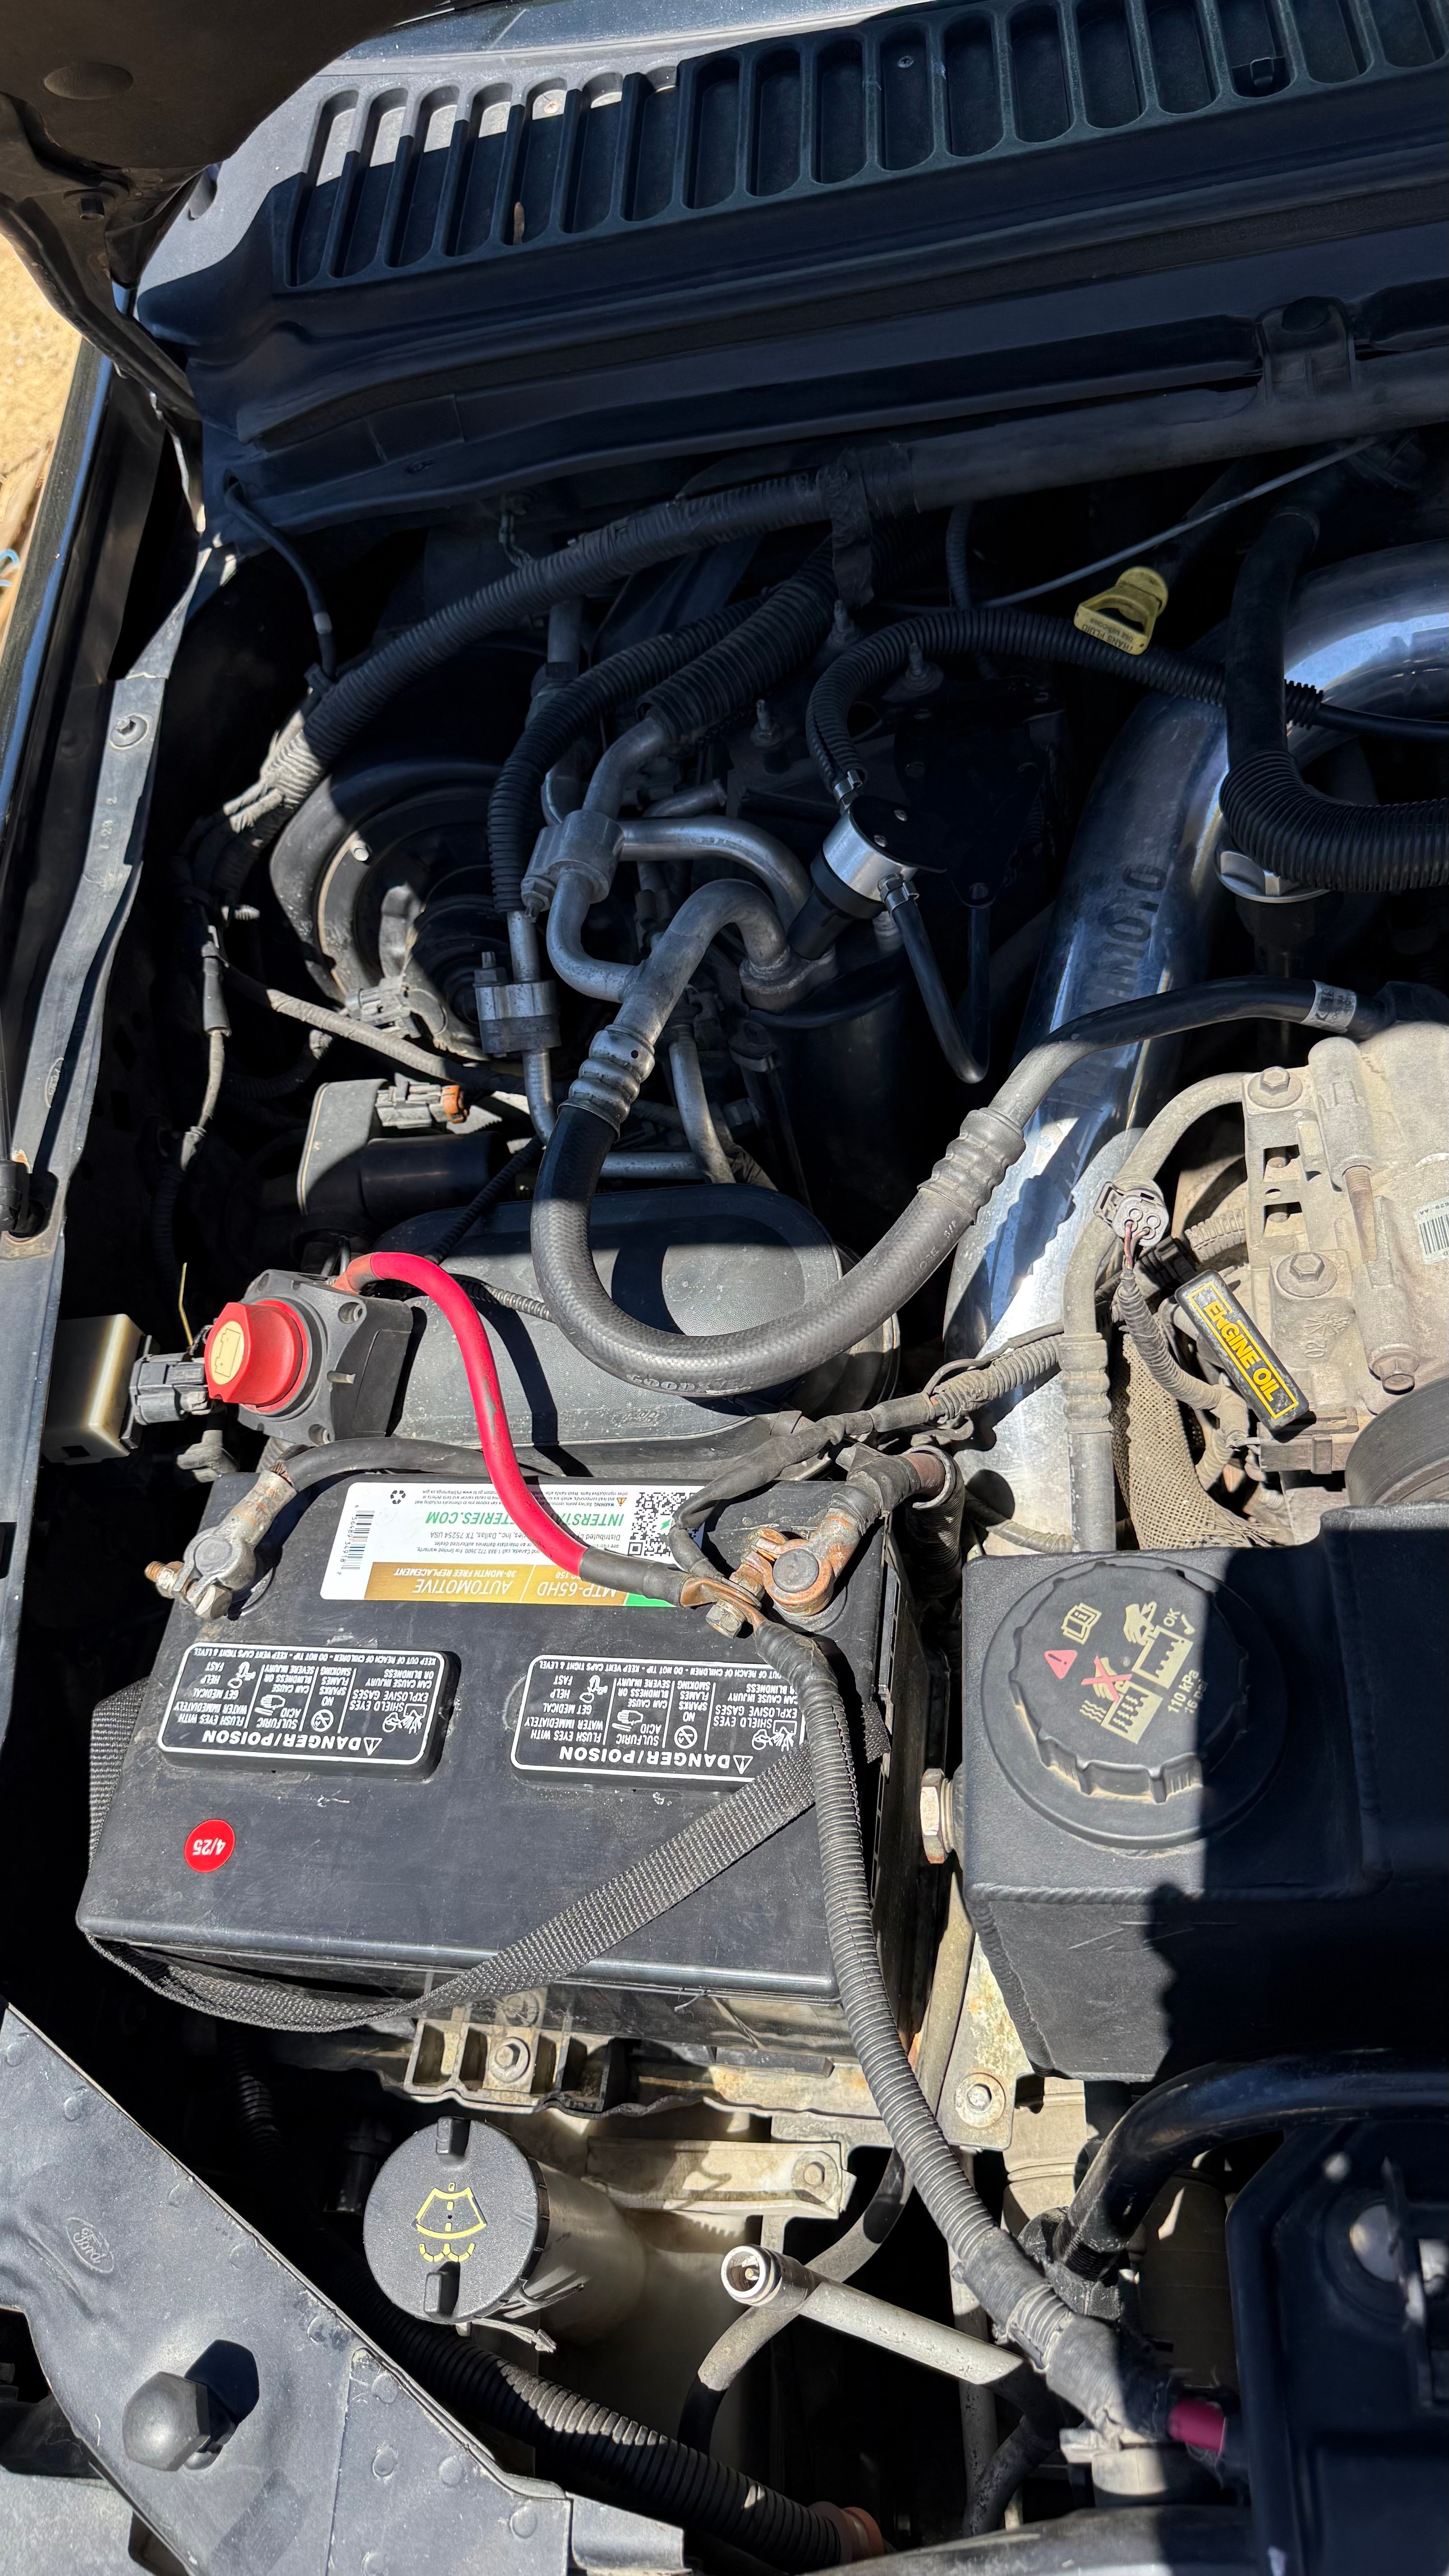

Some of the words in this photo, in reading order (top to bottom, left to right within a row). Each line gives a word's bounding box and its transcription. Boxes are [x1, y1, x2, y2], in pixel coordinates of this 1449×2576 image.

[1082, 624, 1105, 638] FLUID
[1107, 635, 1133, 652] TRANS
[1204, 1300, 1261, 1369] ENGINE
[1253, 1368, 1279, 1403] OIL
[393, 1568, 452, 1576] REPLACEMENT
[452, 1569, 472, 1577] FREE
[474, 1569, 517, 1578] 30-MONTH
[412, 1578, 513, 1595] AUTOMOTIVE
[537, 1581, 616, 1598] MTP-65HD
[1163, 1608, 1181, 1627] OK
[194, 1647, 212, 1656] LEVEL
[219, 1649, 237, 1657] TIGHT
[237, 1650, 254, 1658] CAPS
[255, 1651, 271, 1659] VENT
[271, 1651, 288, 1660] KEEP
[305, 1653, 318, 1661] NOT
[334, 1654, 365, 1662] CHILDREN
[365, 1655, 374, 1663] OF
[376, 1655, 396, 1664] REACH
[420, 1657, 436, 1665] KEEP
[205, 1662, 225, 1671] FAST
[263, 1665, 289, 1673] INJURY
[290, 1665, 315, 1673] SEVERE
[539, 1661, 559, 1669] LEVEL
[560, 1661, 565, 1670] &
[566, 1662, 585, 1670] TIGHT
[586, 1662, 604, 1671] CAPS
[605, 1664, 621, 1672] VENT
[659, 1666, 672, 1674] NOT
[320, 1666, 352, 1675] SMOKING
[383, 1669, 422, 1679] BLINDNESS
[424, 1670, 434, 1679] OR
[690, 1667, 723, 1677] CHILDREN
[724, 1669, 733, 1677] OF
[734, 1669, 756, 1678] REACH
[768, 1671, 782, 1679] OUT
[200, 1674, 221, 1684] HELP
[263, 1674, 274, 1682] OR
[276, 1674, 313, 1684] BLINDNESS
[321, 1676, 349, 1686] FLAMES
[365, 1678, 392, 1687] INJURY
[553, 1675, 573, 1685] FAST
[616, 1678, 642, 1687] INJURY
[271, 1684, 294, 1693] CAUSE
[393, 1679, 416, 1688] CAUSE
[417, 1679, 432, 1688] CAN
[644, 1679, 671, 1688] SEVERE
[677, 1680, 710, 1690] SMOKING
[193, 1688, 223, 1699] MEDICAL
[295, 1685, 309, 1693] CAN
[319, 1685, 347, 1695] SPARKS
[550, 1688, 570, 1699] HELP
[618, 1688, 628, 1696] OR
[630, 1688, 669, 1698] BLINDNESS
[746, 1684, 787, 1694] BLINDNESS
[1168, 1692, 1187, 1713] 110
[1178, 1670, 1200, 1692] kPa
[223, 1690, 239, 1699] GET
[352, 1689, 380, 1700] GASES
[383, 1690, 429, 1702] EXPLOSIVE
[680, 1690, 709, 1701] FLAMES
[727, 1693, 755, 1702] INJURY
[757, 1694, 782, 1703] CAUSE
[322, 1696, 334, 1706] NO
[350, 1700, 371, 1711] EYES
[627, 1698, 650, 1707] CAUSE
[652, 1700, 667, 1709] CAN
[678, 1701, 708, 1711] SPARKS
[173, 1701, 221, 1714] IMMEDIATELY
[222, 1704, 247, 1714] WATER
[373, 1701, 405, 1712] SHIELD
[543, 1703, 575, 1714] MEDICAL
[576, 1704, 592, 1715] GET
[715, 1704, 745, 1716] GASES
[280, 1708, 301, 1718] ACID
[683, 1711, 695, 1722] NO
[749, 1706, 797, 1718] EXPLOSIVE
[178, 1713, 197, 1724] WITH
[199, 1714, 219, 1725] EYES
[220, 1716, 245, 1726] FLUSH
[256, 1718, 298, 1729] SULFURIC
[524, 1716, 575, 1729] IMMEDIATELY
[713, 1716, 736, 1727] EYES
[740, 1717, 772, 1729] SHIELD
[577, 1719, 603, 1730] WATER
[640, 1724, 662, 1734] ACID
[530, 1729, 551, 1739] WITH
[554, 1730, 574, 1741] EYES
[576, 1732, 602, 1743] FLUSH
[201, 1730, 362, 1750] DANGER/POISON
[616, 1734, 659, 1746] SULFURIC
[559, 1746, 731, 1769] DANGER/POISON
[192, 1837, 226, 1855] 4/25
